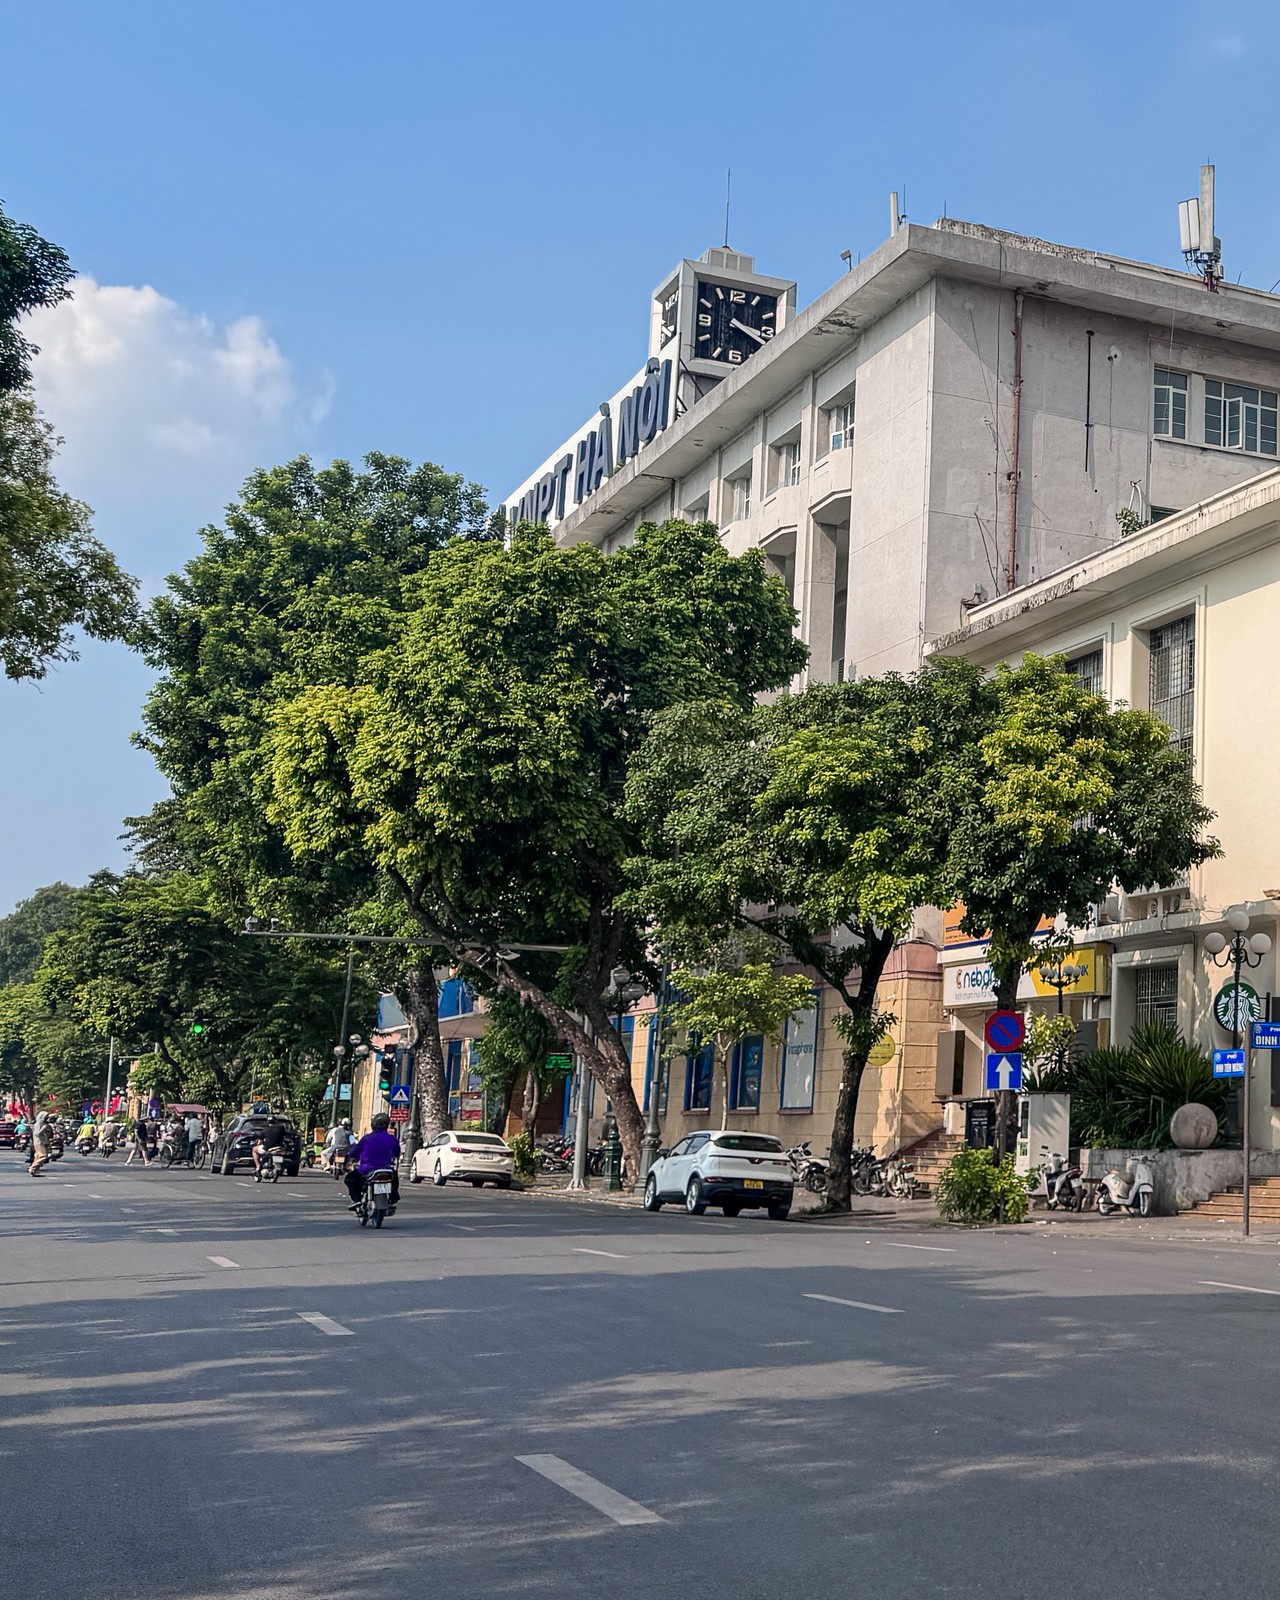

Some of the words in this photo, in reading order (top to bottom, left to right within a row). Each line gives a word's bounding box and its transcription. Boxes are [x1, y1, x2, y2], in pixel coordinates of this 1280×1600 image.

[730, 290, 746, 304] 12
[699, 313, 712, 327] 9
[761, 326, 774, 339] 3
[728, 349, 742, 362] 6
